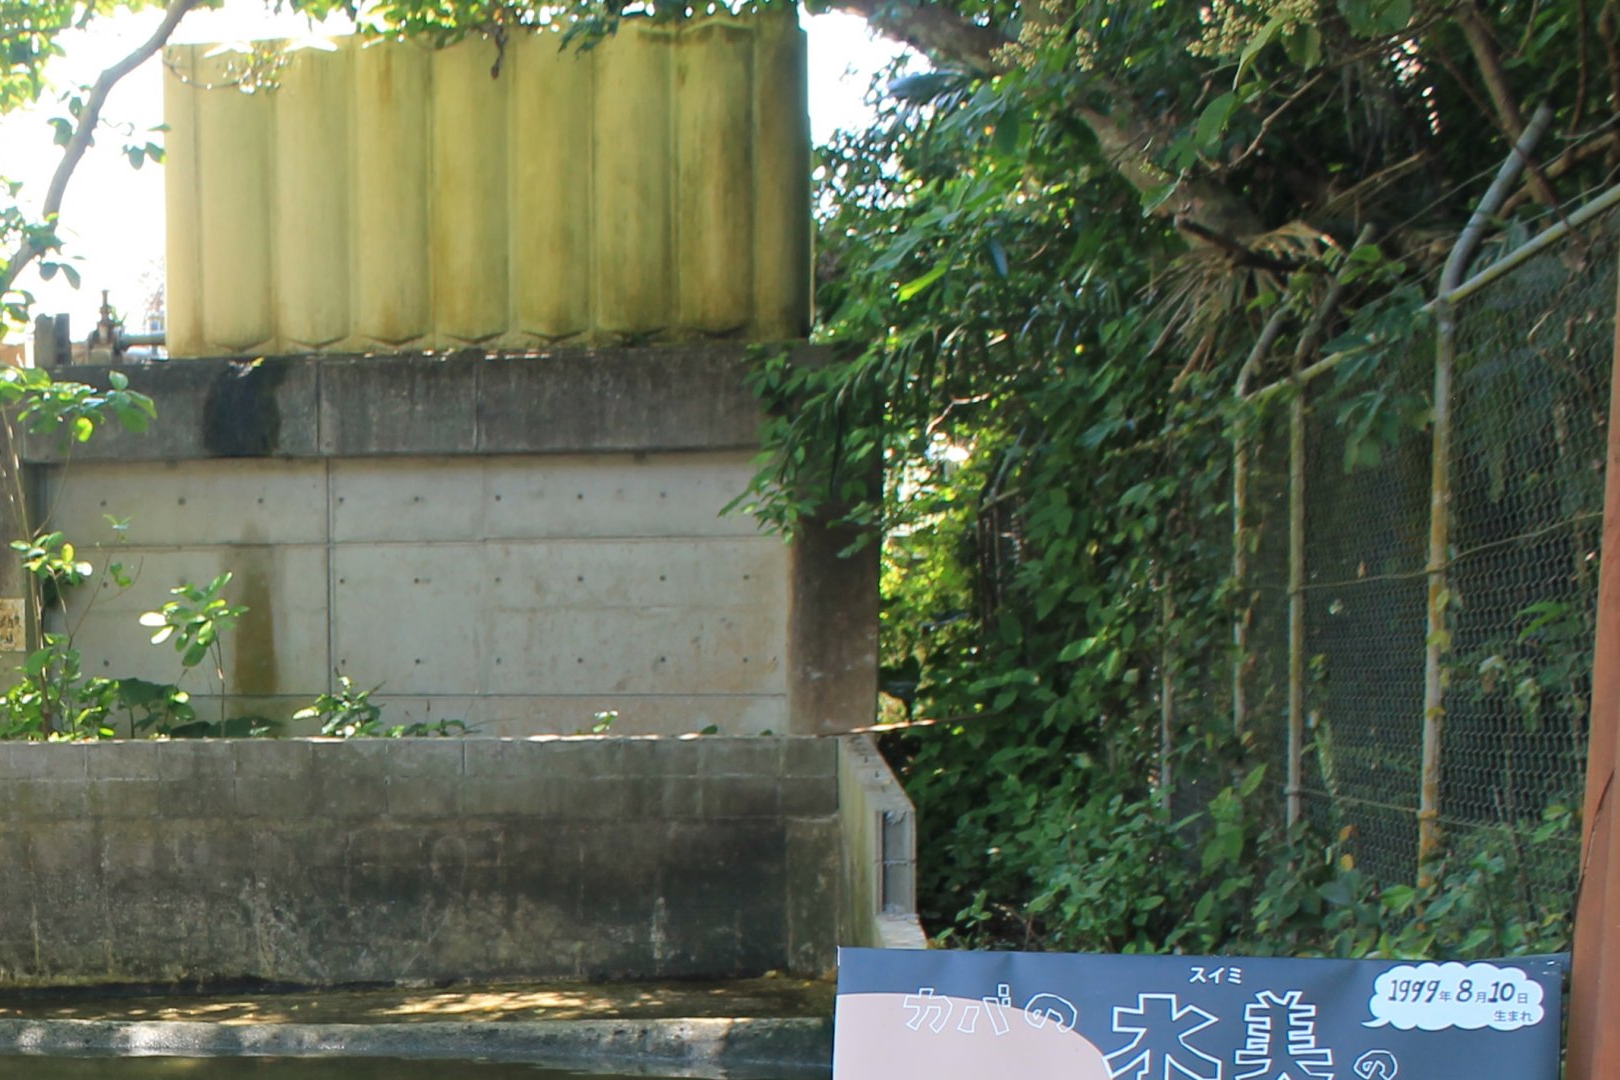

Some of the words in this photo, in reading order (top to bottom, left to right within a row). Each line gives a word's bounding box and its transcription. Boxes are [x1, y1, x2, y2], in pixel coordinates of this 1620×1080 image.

[1189, 966, 1242, 984] スイミ
[1388, 979, 1529, 1004] 1999年8月10日
[1494, 1010, 1533, 1022] 生まれ
